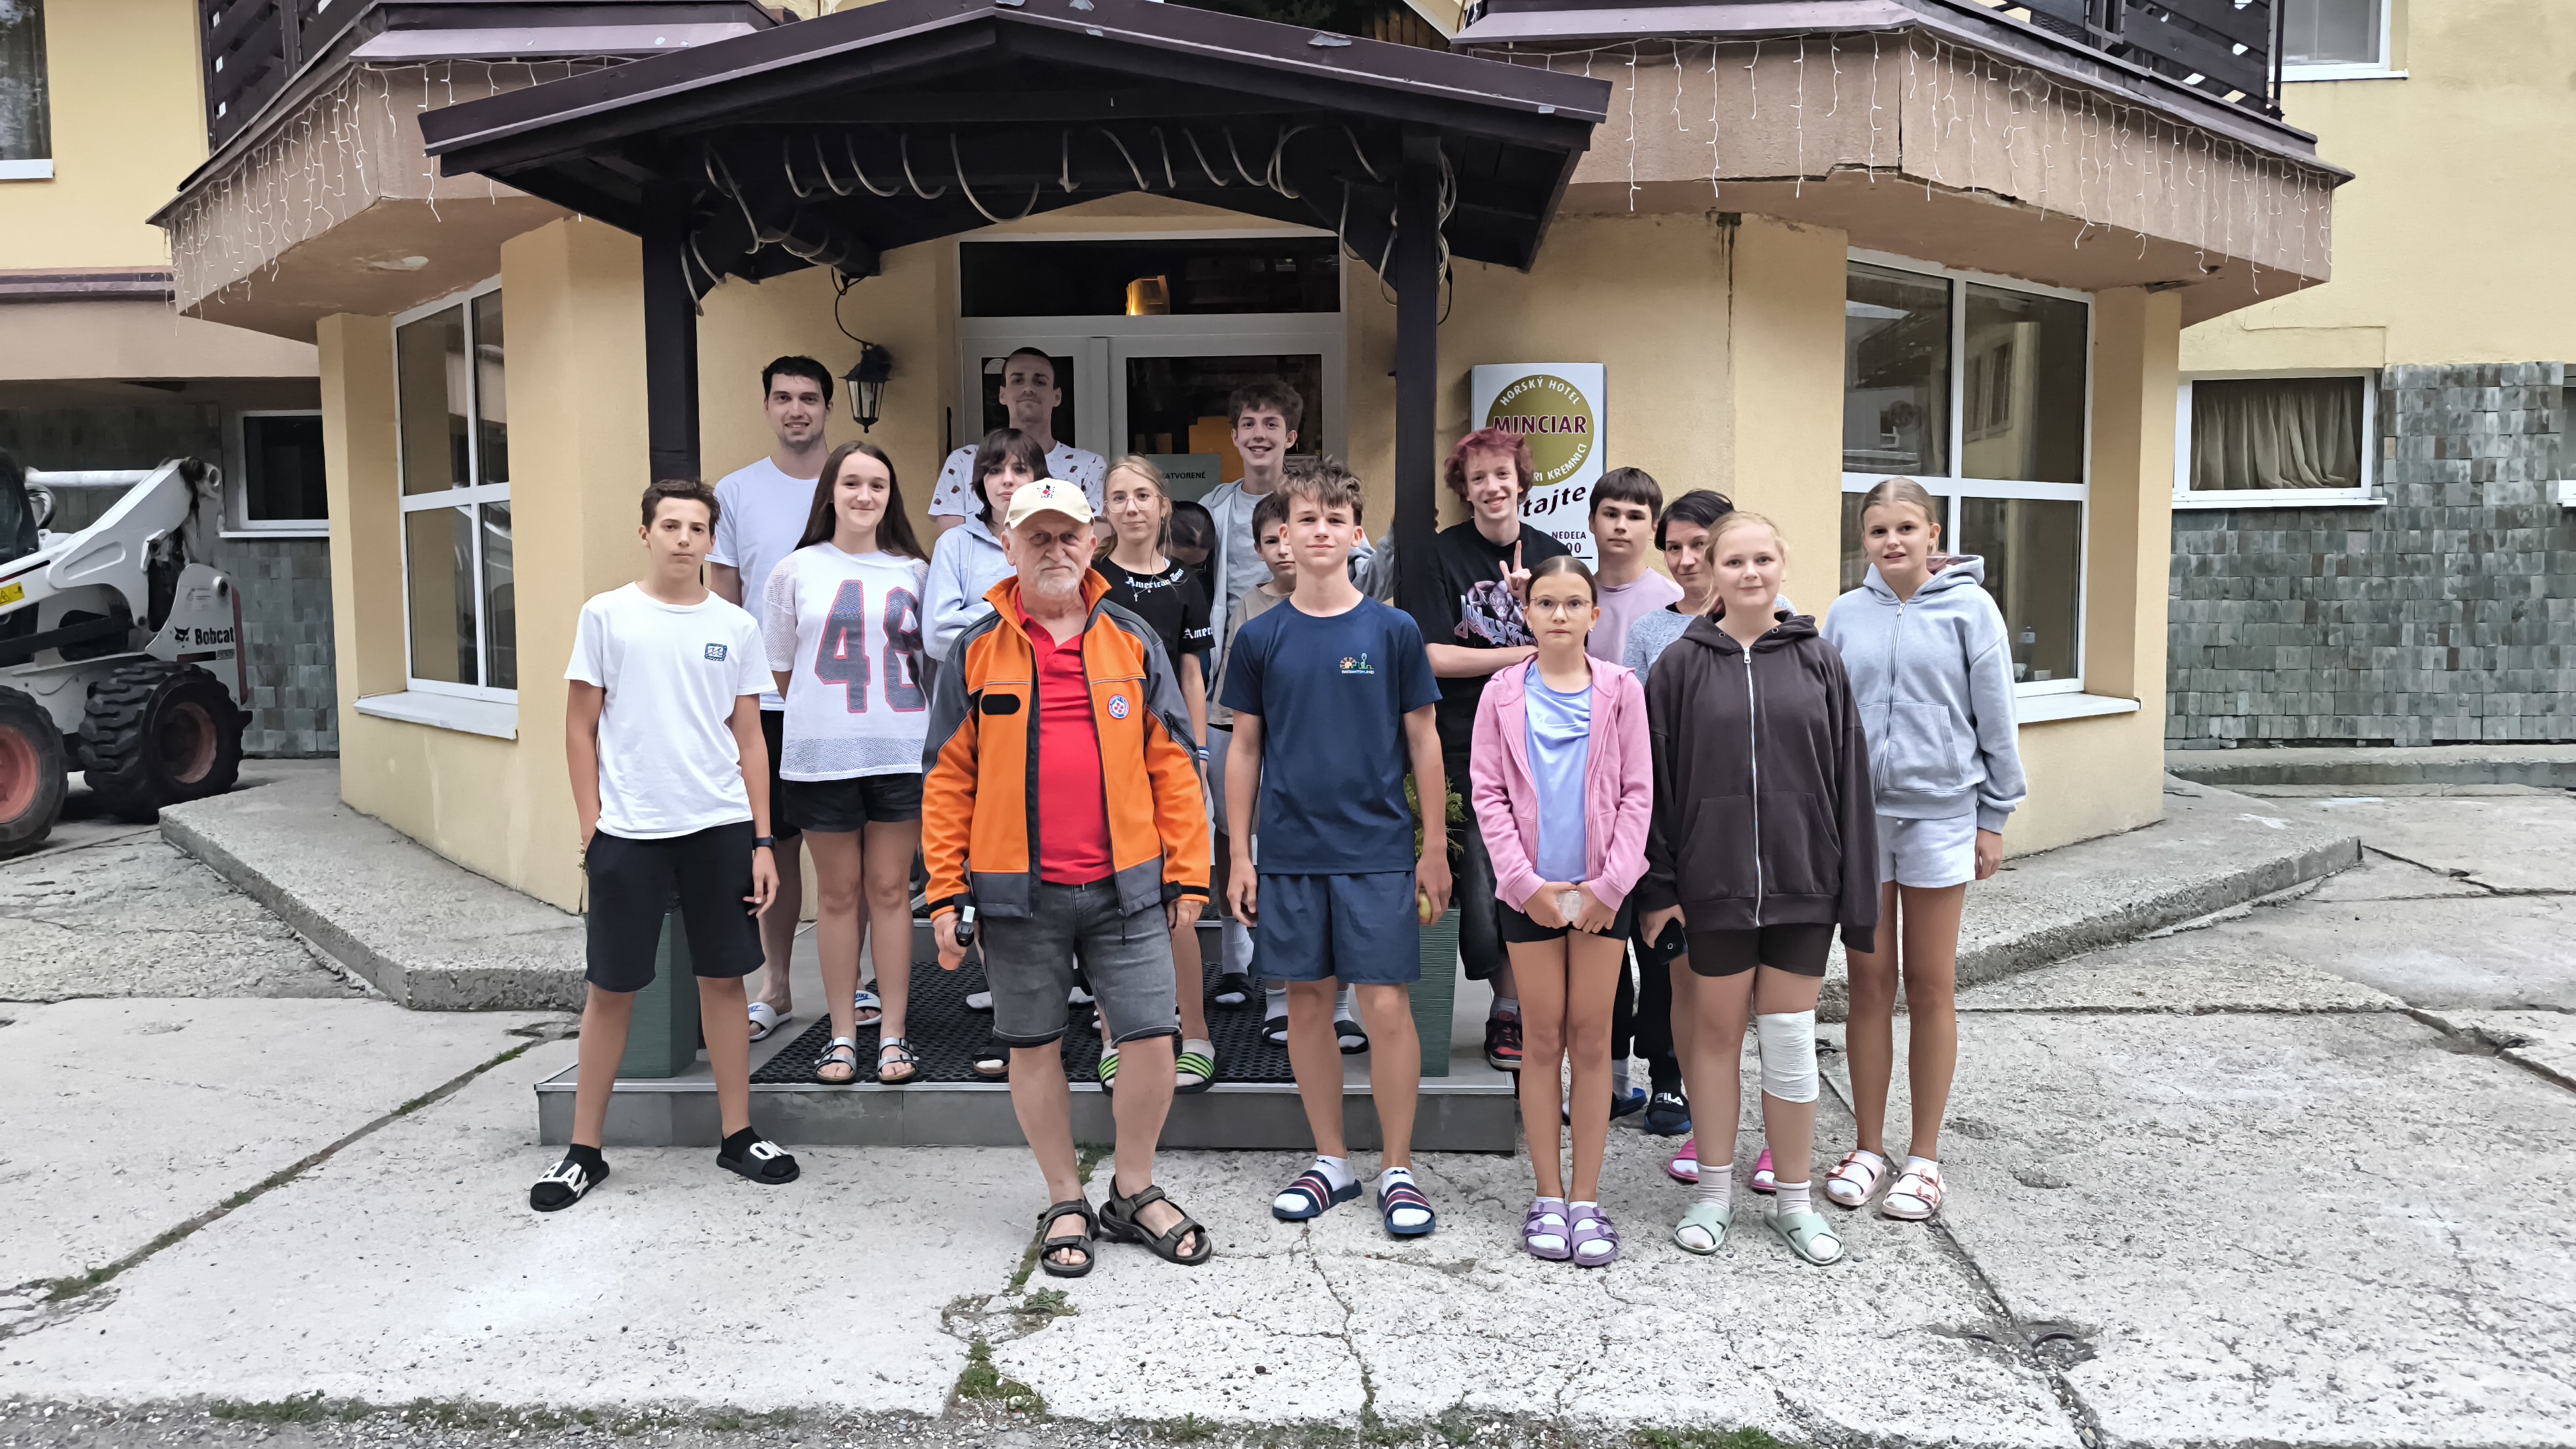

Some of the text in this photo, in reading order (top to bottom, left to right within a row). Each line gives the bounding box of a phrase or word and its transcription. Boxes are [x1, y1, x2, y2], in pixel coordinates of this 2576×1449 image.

[1500, 376, 1580, 406] HORSKÝ HOTEL
[1493, 415, 1587, 434] MINCIAR
[1533, 443, 1587, 482] RI KREMNICI
[1164, 471, 1205, 479] ATVORENÉ
[1523, 486, 1586, 517] tajte
[1552, 531, 1587, 539] NEDEĽA
[1125, 576, 1171, 589] American
[195, 627, 235, 645] Bobcat
[1182, 627, 1214, 639] Amer
[1655, 1092, 1684, 1106] FILA
[536, 1160, 589, 1198] ELAX
